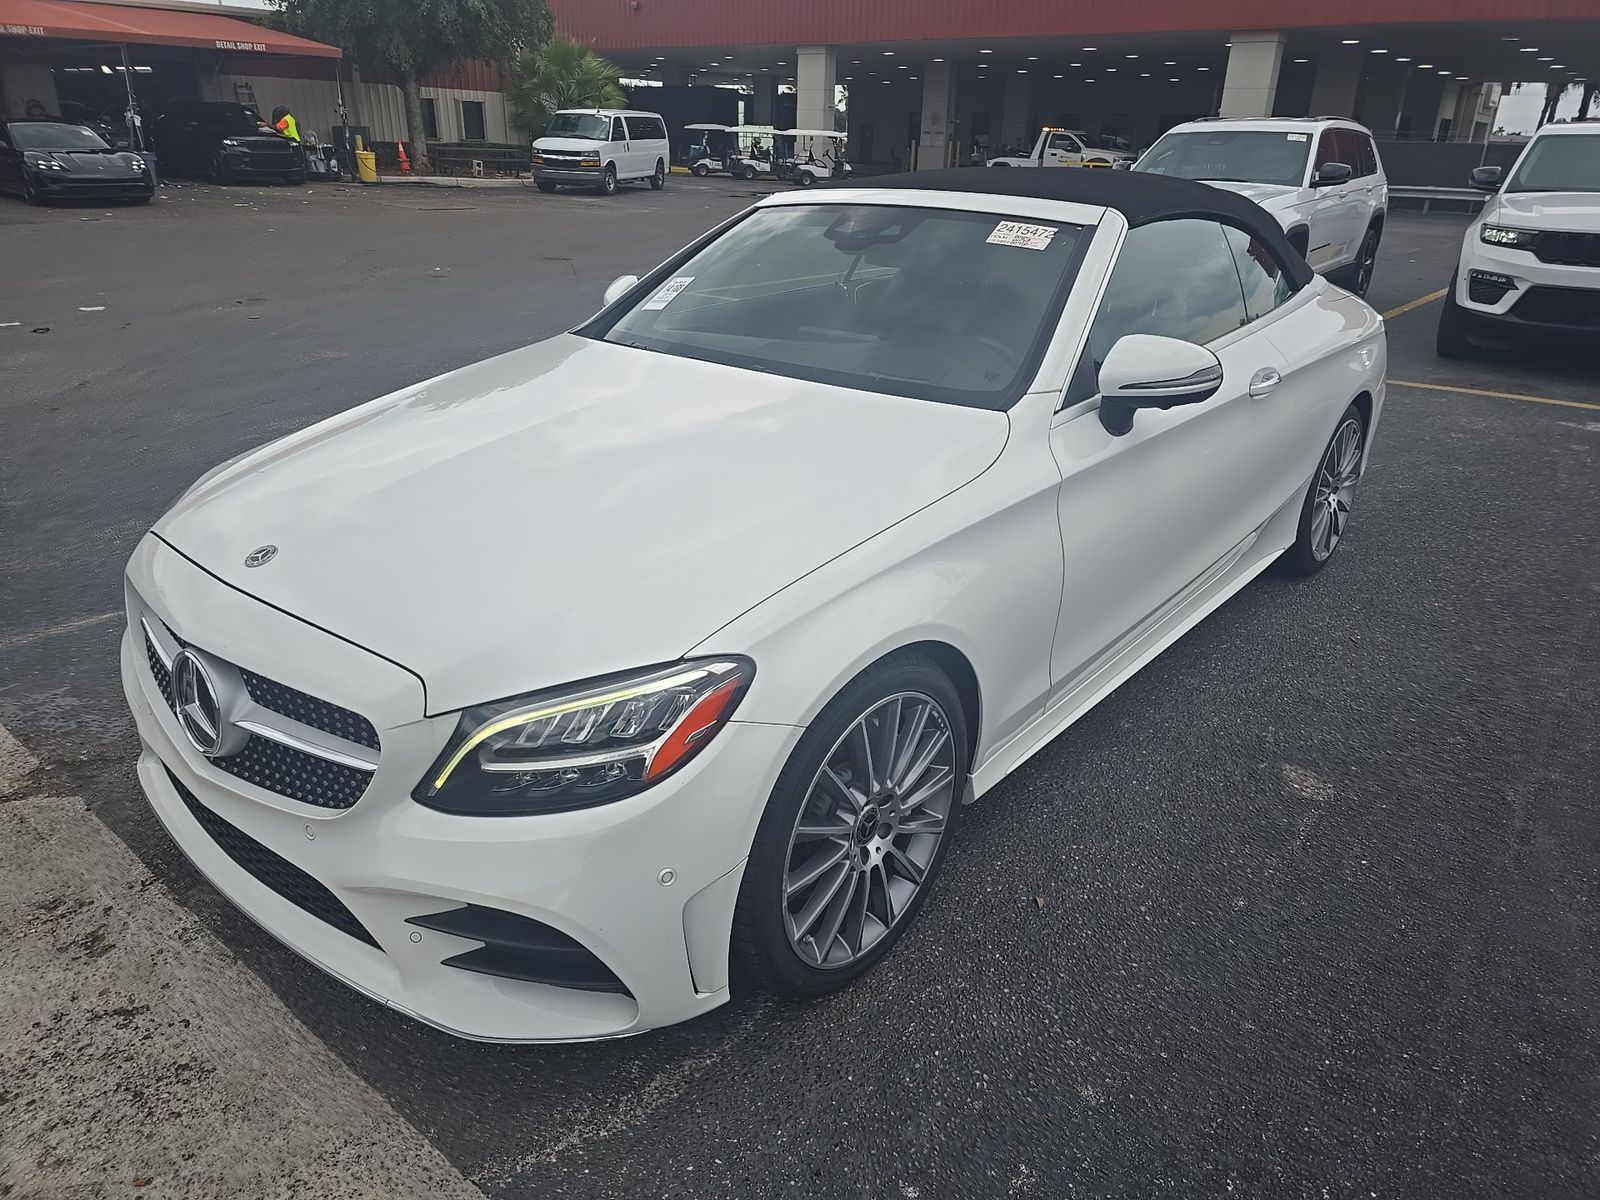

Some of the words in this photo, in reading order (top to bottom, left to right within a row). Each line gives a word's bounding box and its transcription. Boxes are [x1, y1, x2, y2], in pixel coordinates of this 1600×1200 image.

[28, 26, 45, 35] EXIT
[215, 40, 236, 49] DETAIL
[236, 42, 252, 50] SHOP
[253, 43, 266, 51] EXIT
[996, 223, 1056, 239] 2415472
